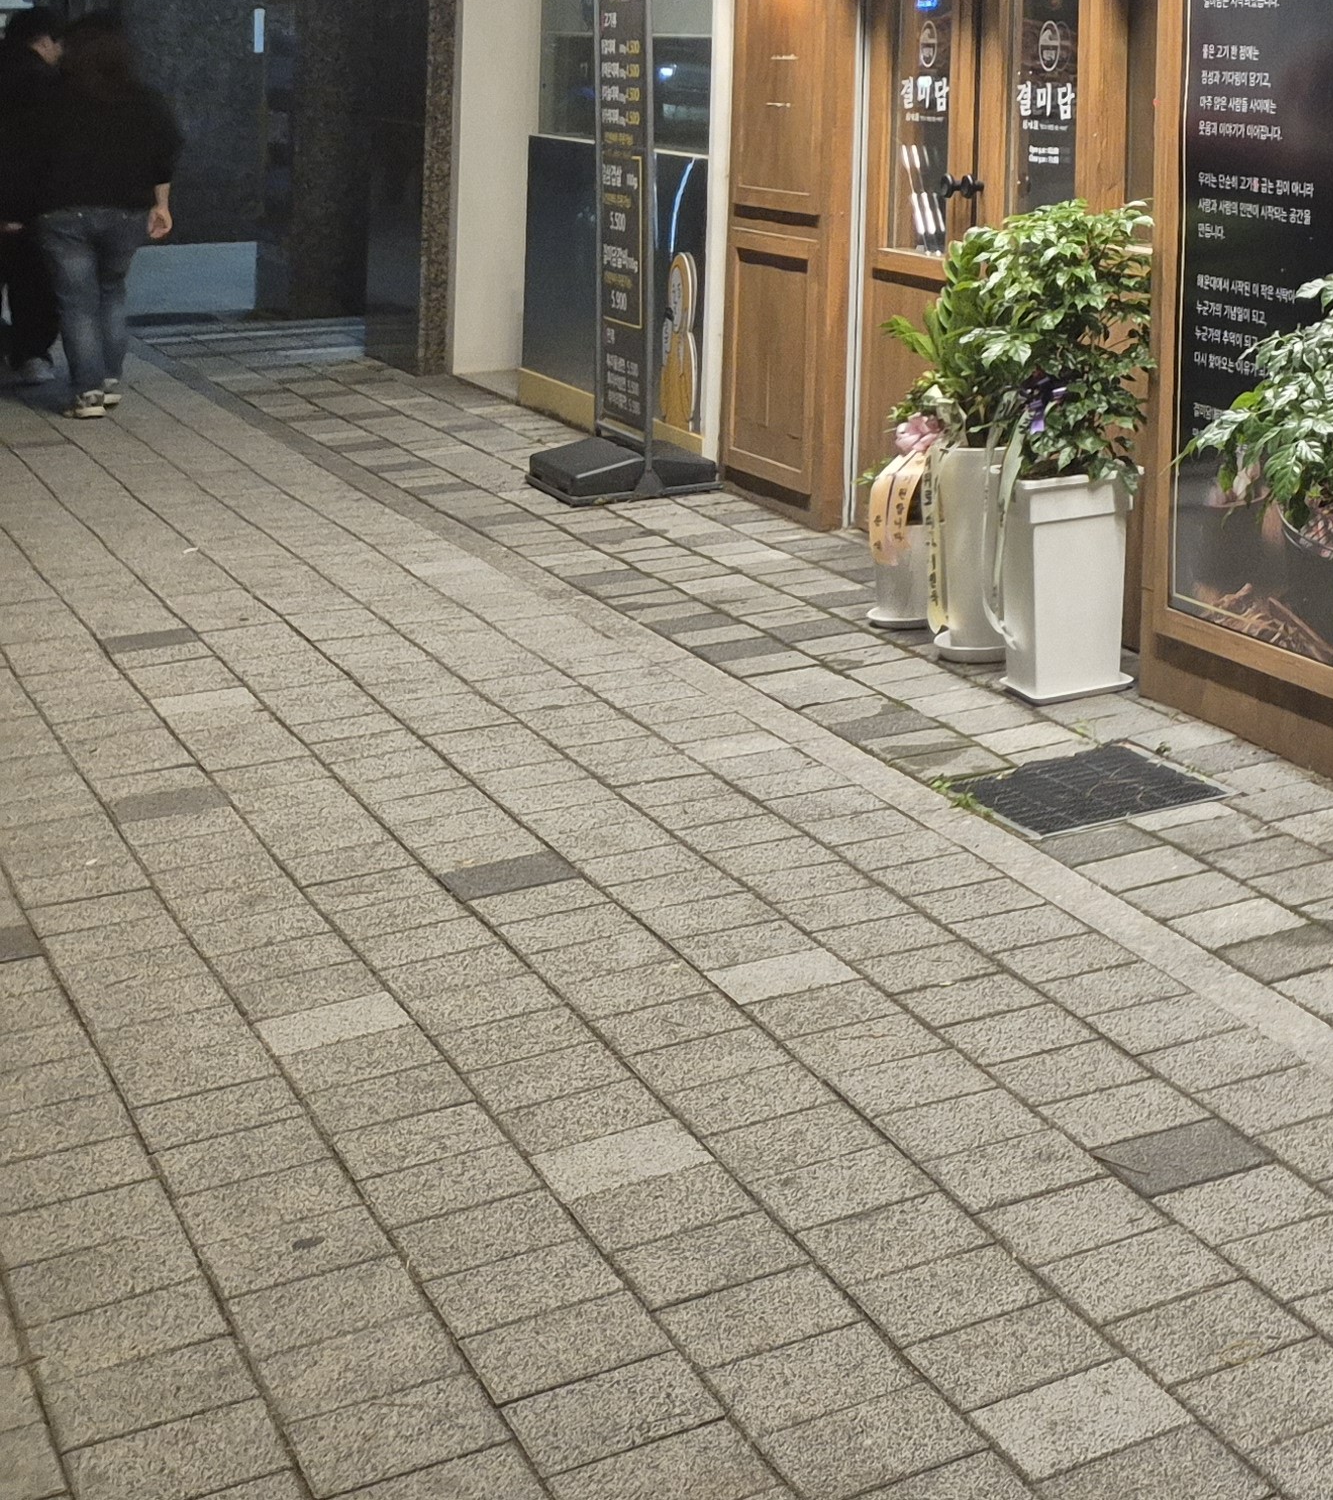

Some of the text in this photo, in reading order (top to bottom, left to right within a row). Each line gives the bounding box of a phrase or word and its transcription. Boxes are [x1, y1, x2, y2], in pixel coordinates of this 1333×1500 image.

[1216, 45, 1230, 59] 고기
[901, 76, 949, 112] 결미담
[1017, 81, 1075, 120] 결미담
[1198, 172, 1217, 188] 우리는
[1291, 181, 1314, 198] 아니라
[1289, 208, 1311, 225] 공간을
[1252, 283, 1259, 297] 이
[1196, 300, 1222, 318] 누군가의
[1195, 325, 1221, 343] 누군가의
[1194, 351, 1207, 367] 다시
[1208, 353, 1234, 373] 찾아오는
